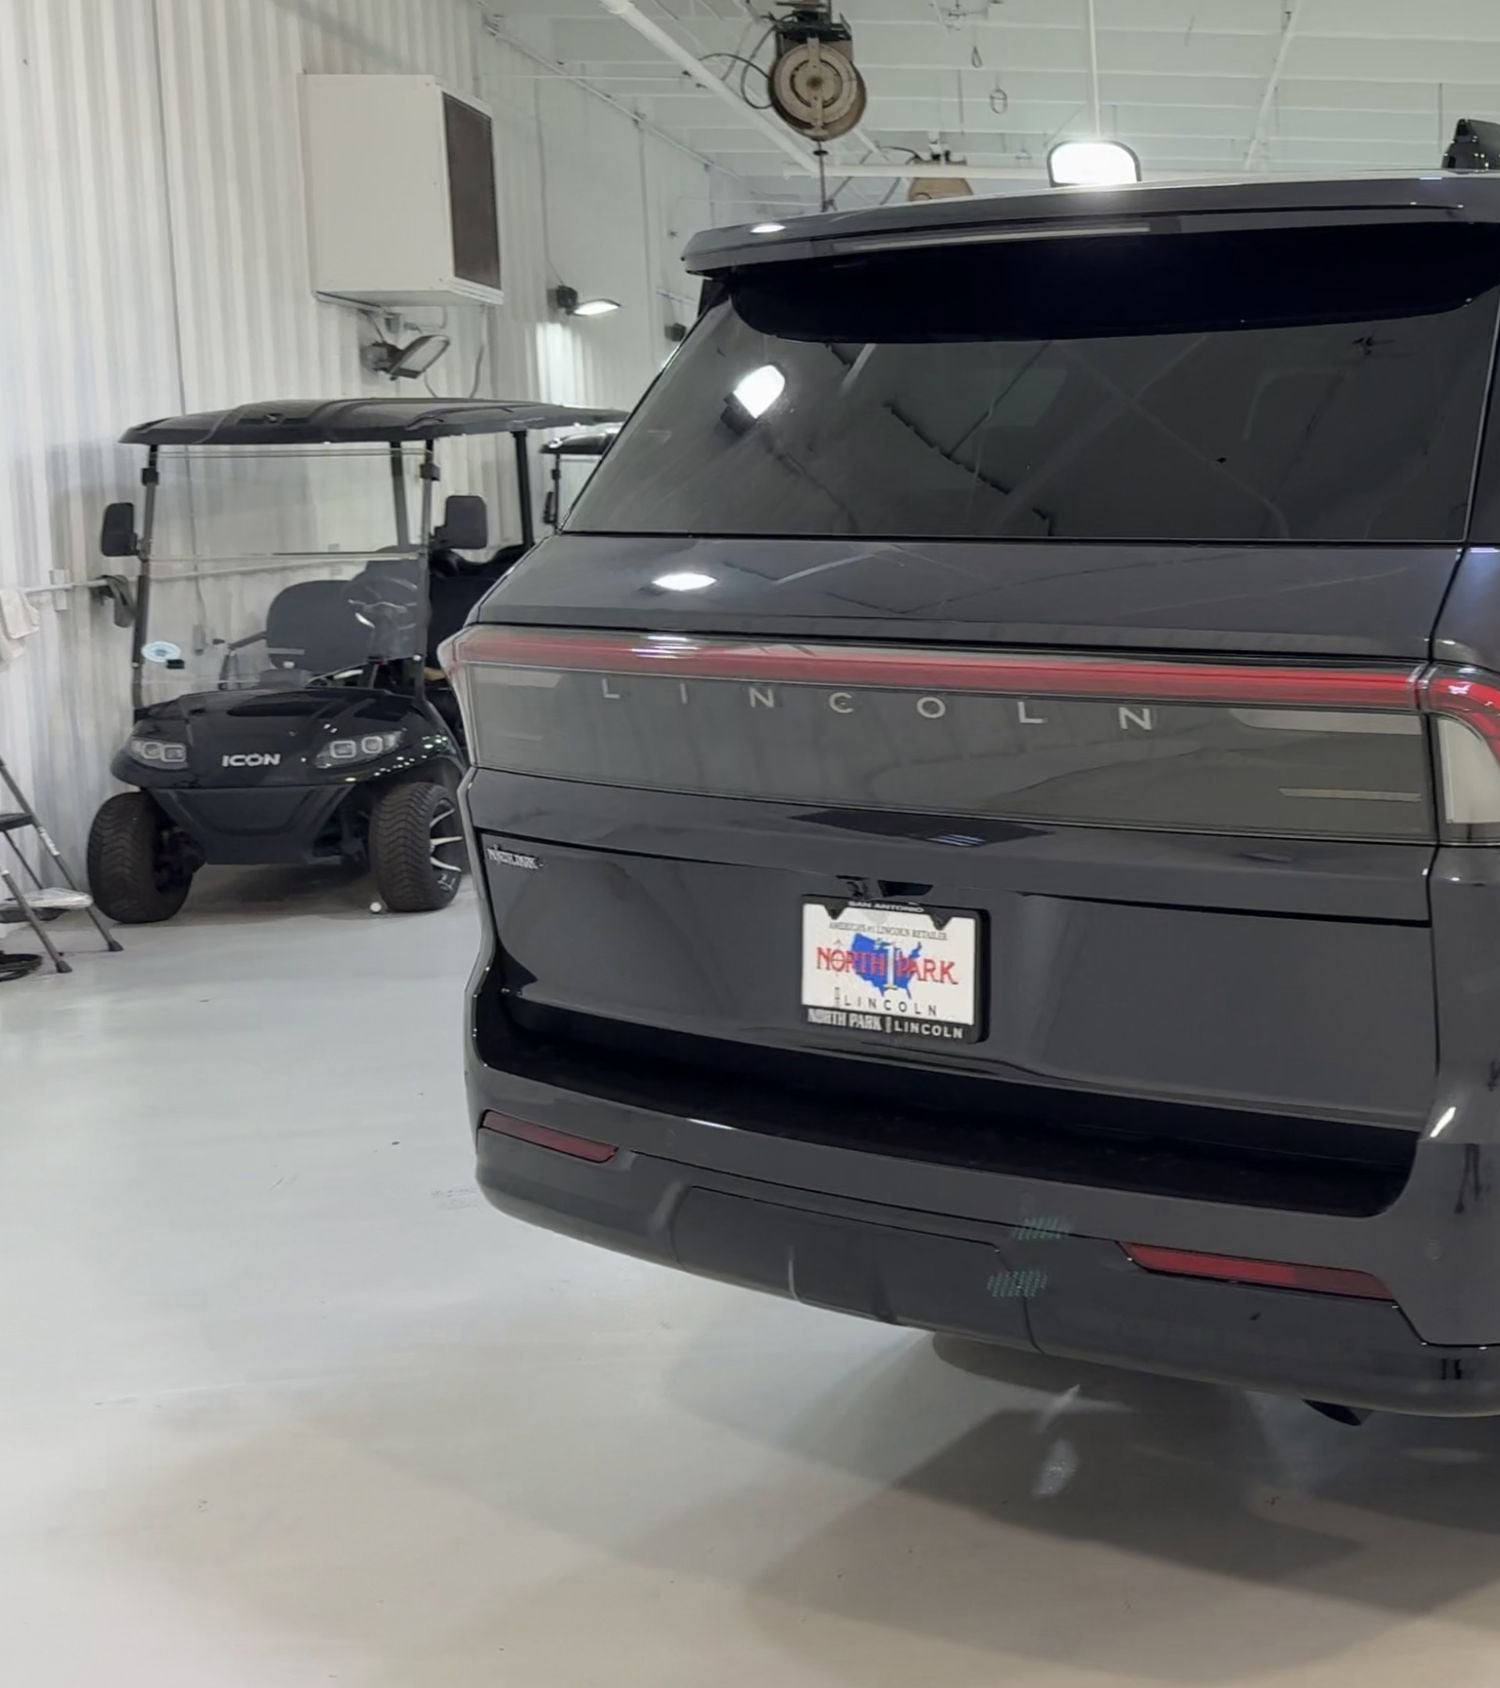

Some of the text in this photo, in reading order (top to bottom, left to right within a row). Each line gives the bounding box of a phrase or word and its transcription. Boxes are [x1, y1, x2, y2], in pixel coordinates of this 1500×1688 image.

[602, 678, 1152, 730] LINCOLN
[222, 753, 281, 767] ICON
[816, 947, 959, 985] NORTH PARK
[844, 995, 937, 1016] LINCOLN
[849, 1013, 882, 1031] PARK
[894, 1020, 963, 1039] LINCOLN
